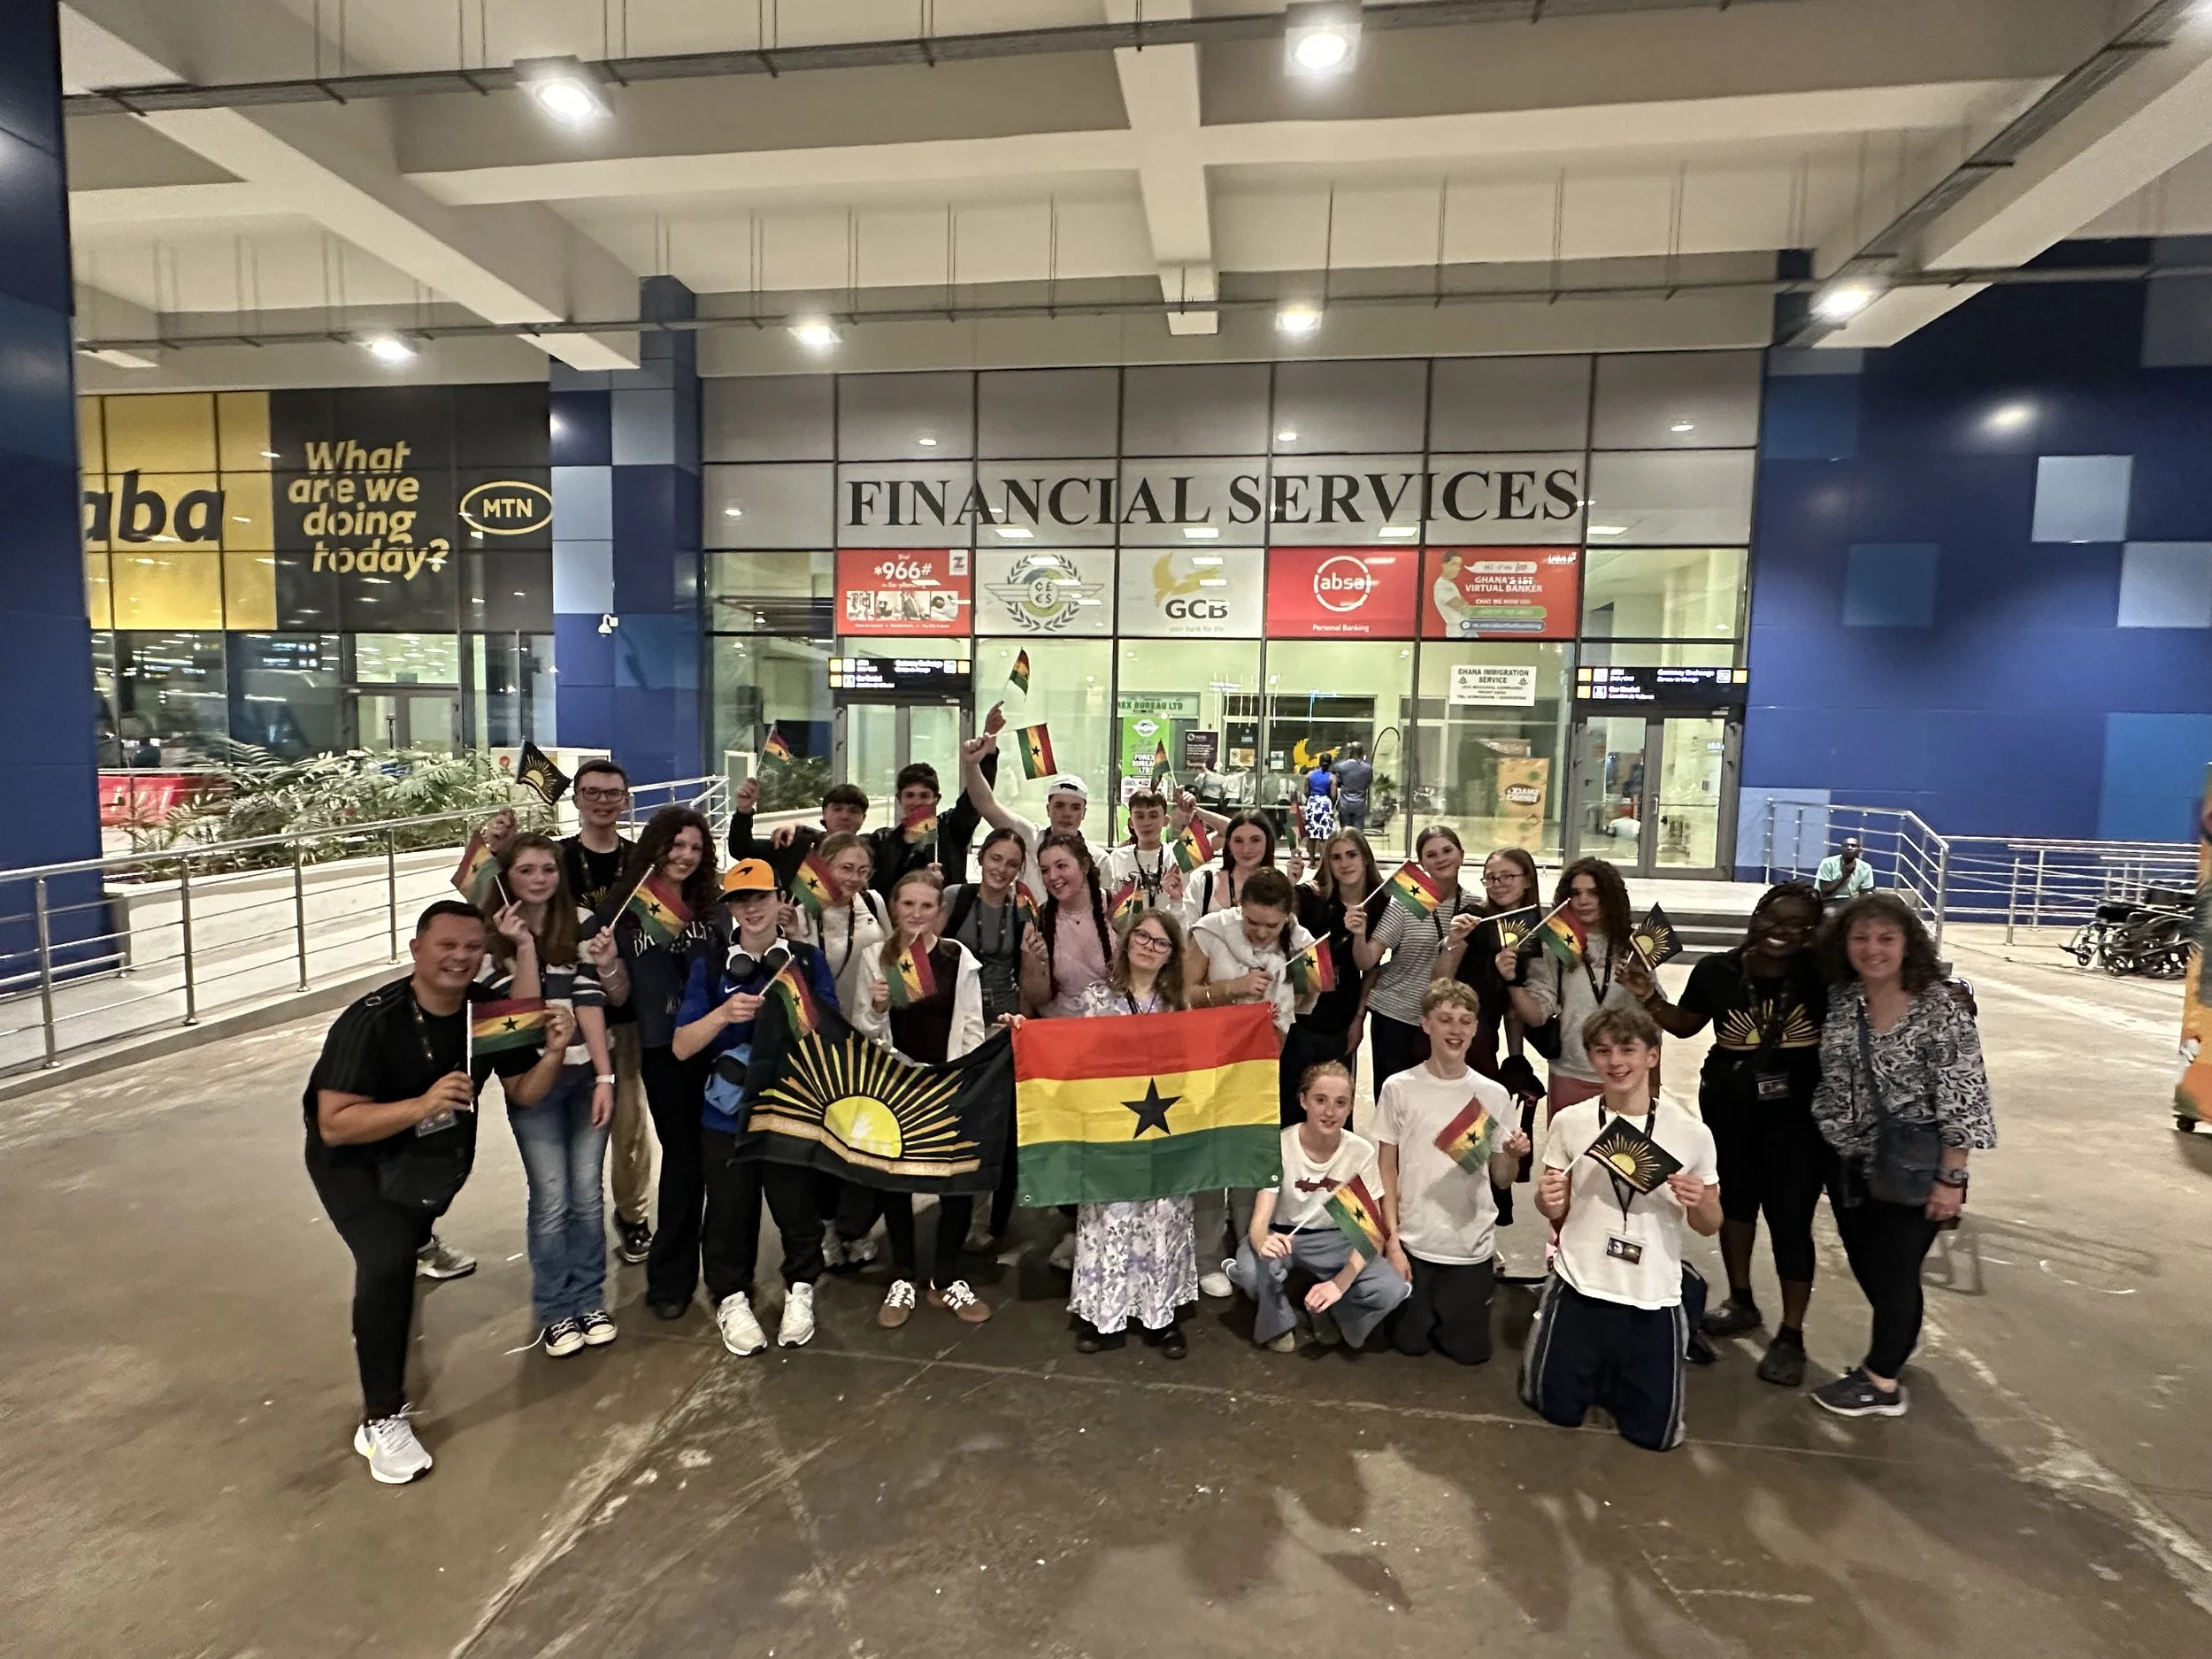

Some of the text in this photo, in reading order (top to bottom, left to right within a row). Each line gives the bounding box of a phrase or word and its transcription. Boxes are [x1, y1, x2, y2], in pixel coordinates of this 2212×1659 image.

[304, 440, 411, 474] What
[288, 477, 420, 504] are we
[845, 470, 1578, 526] FINANCIAL SERVICES
[482, 497, 533, 518] MTN
[303, 507, 416, 544] doing
[312, 538, 449, 580] today?
[1320, 572, 1367, 590] absa
[1465, 584, 1543, 593] VIRTUAL BANKER
[1475, 576, 1516, 585] GHANA'S
[1165, 599, 1228, 618] GCB
[1342, 624, 1370, 633] Banking
[1134, 701, 1166, 710] BUREAU
[1169, 702, 1183, 710] LTD
